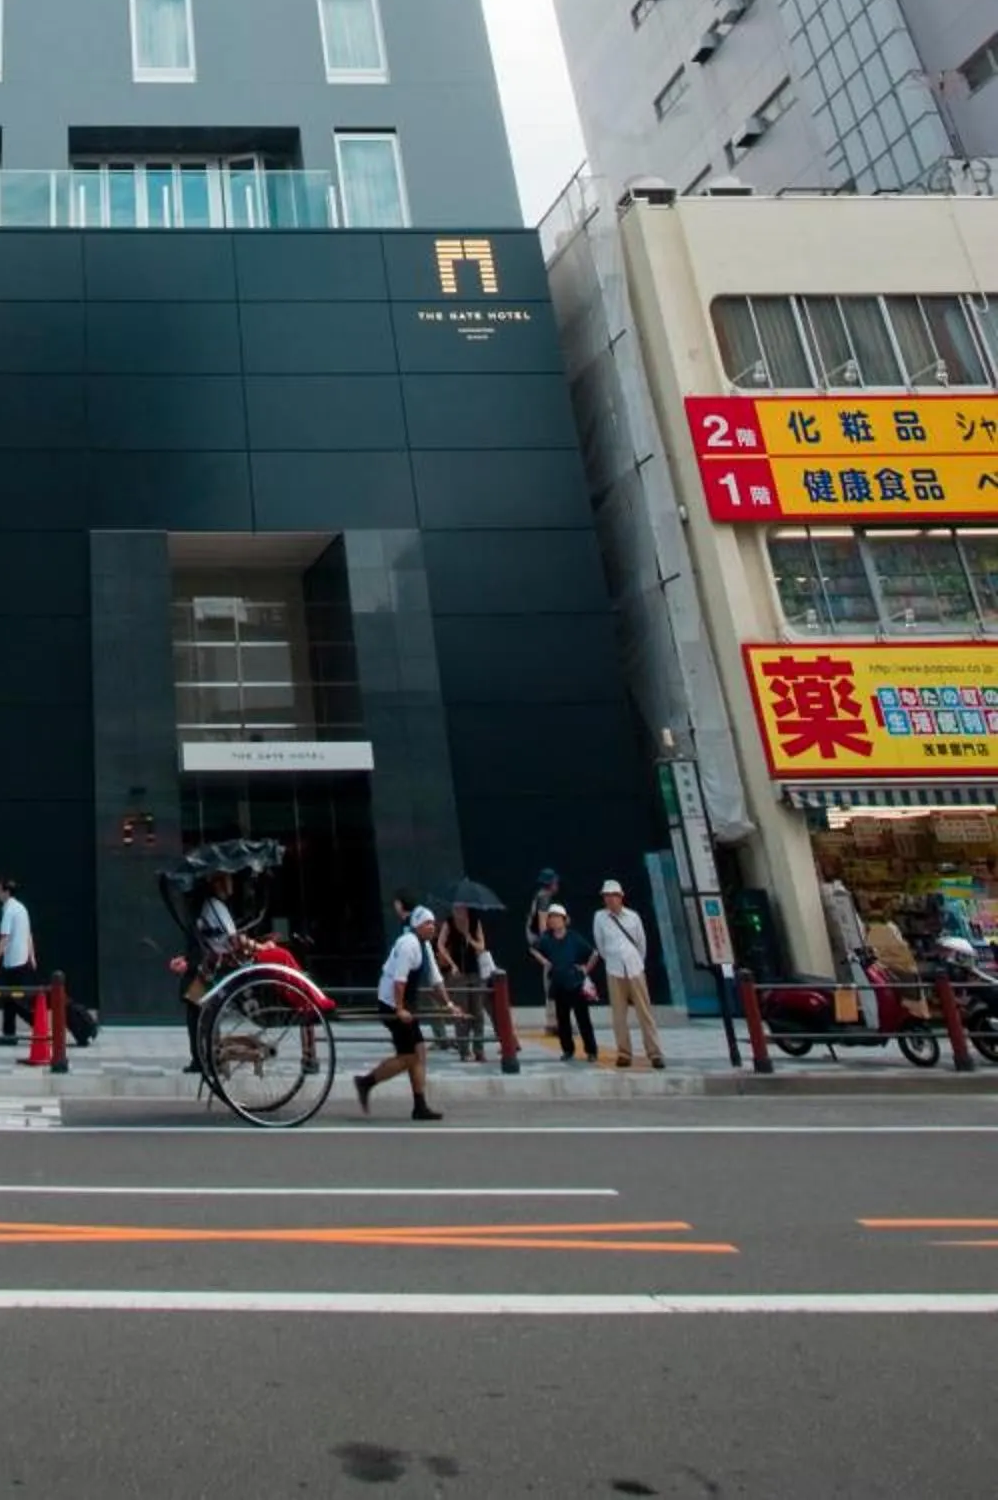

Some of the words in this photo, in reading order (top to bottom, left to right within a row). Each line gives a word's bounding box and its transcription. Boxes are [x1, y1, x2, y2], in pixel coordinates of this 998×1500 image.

[417, 311, 443, 321] THE
[449, 311, 482, 321] GATE
[487, 311, 531, 321] HOTEL
[788, 410, 926, 443] 化粧品
[803, 468, 945, 503] 健康食品
[761, 655, 874, 759] 薬
